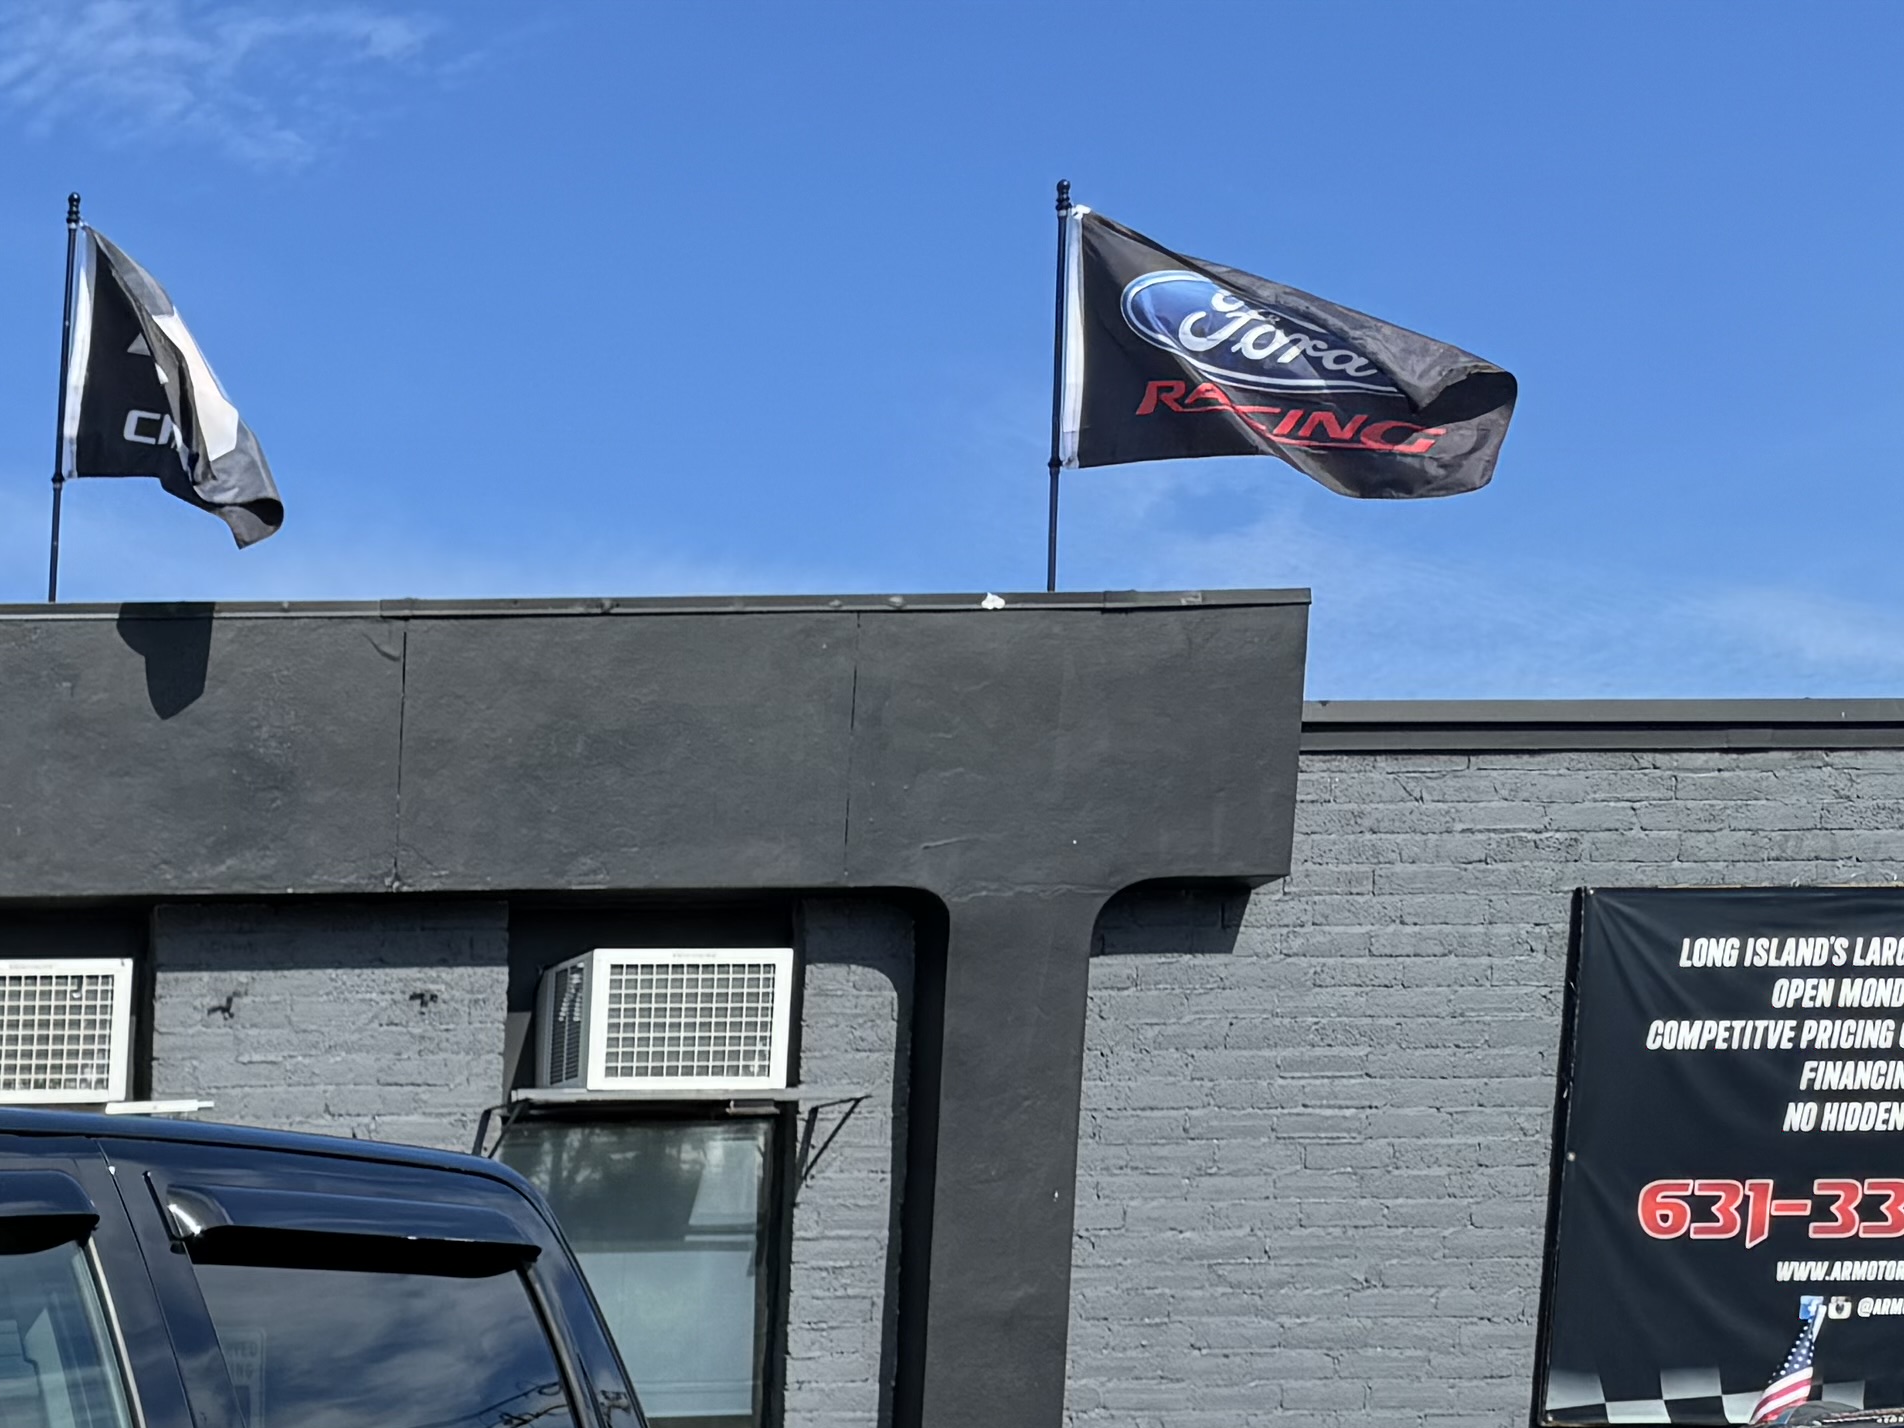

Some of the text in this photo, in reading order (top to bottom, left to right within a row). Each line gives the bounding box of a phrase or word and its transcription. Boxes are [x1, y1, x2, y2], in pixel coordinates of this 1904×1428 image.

[1679, 935, 1904, 968] LONG ISLAND'S LAR
[1771, 977, 1835, 1009] OPEN
[1645, 1019, 1896, 1050] COMPETITVE PRICING
[1782, 1101, 1904, 1132] NO HIDDEN
